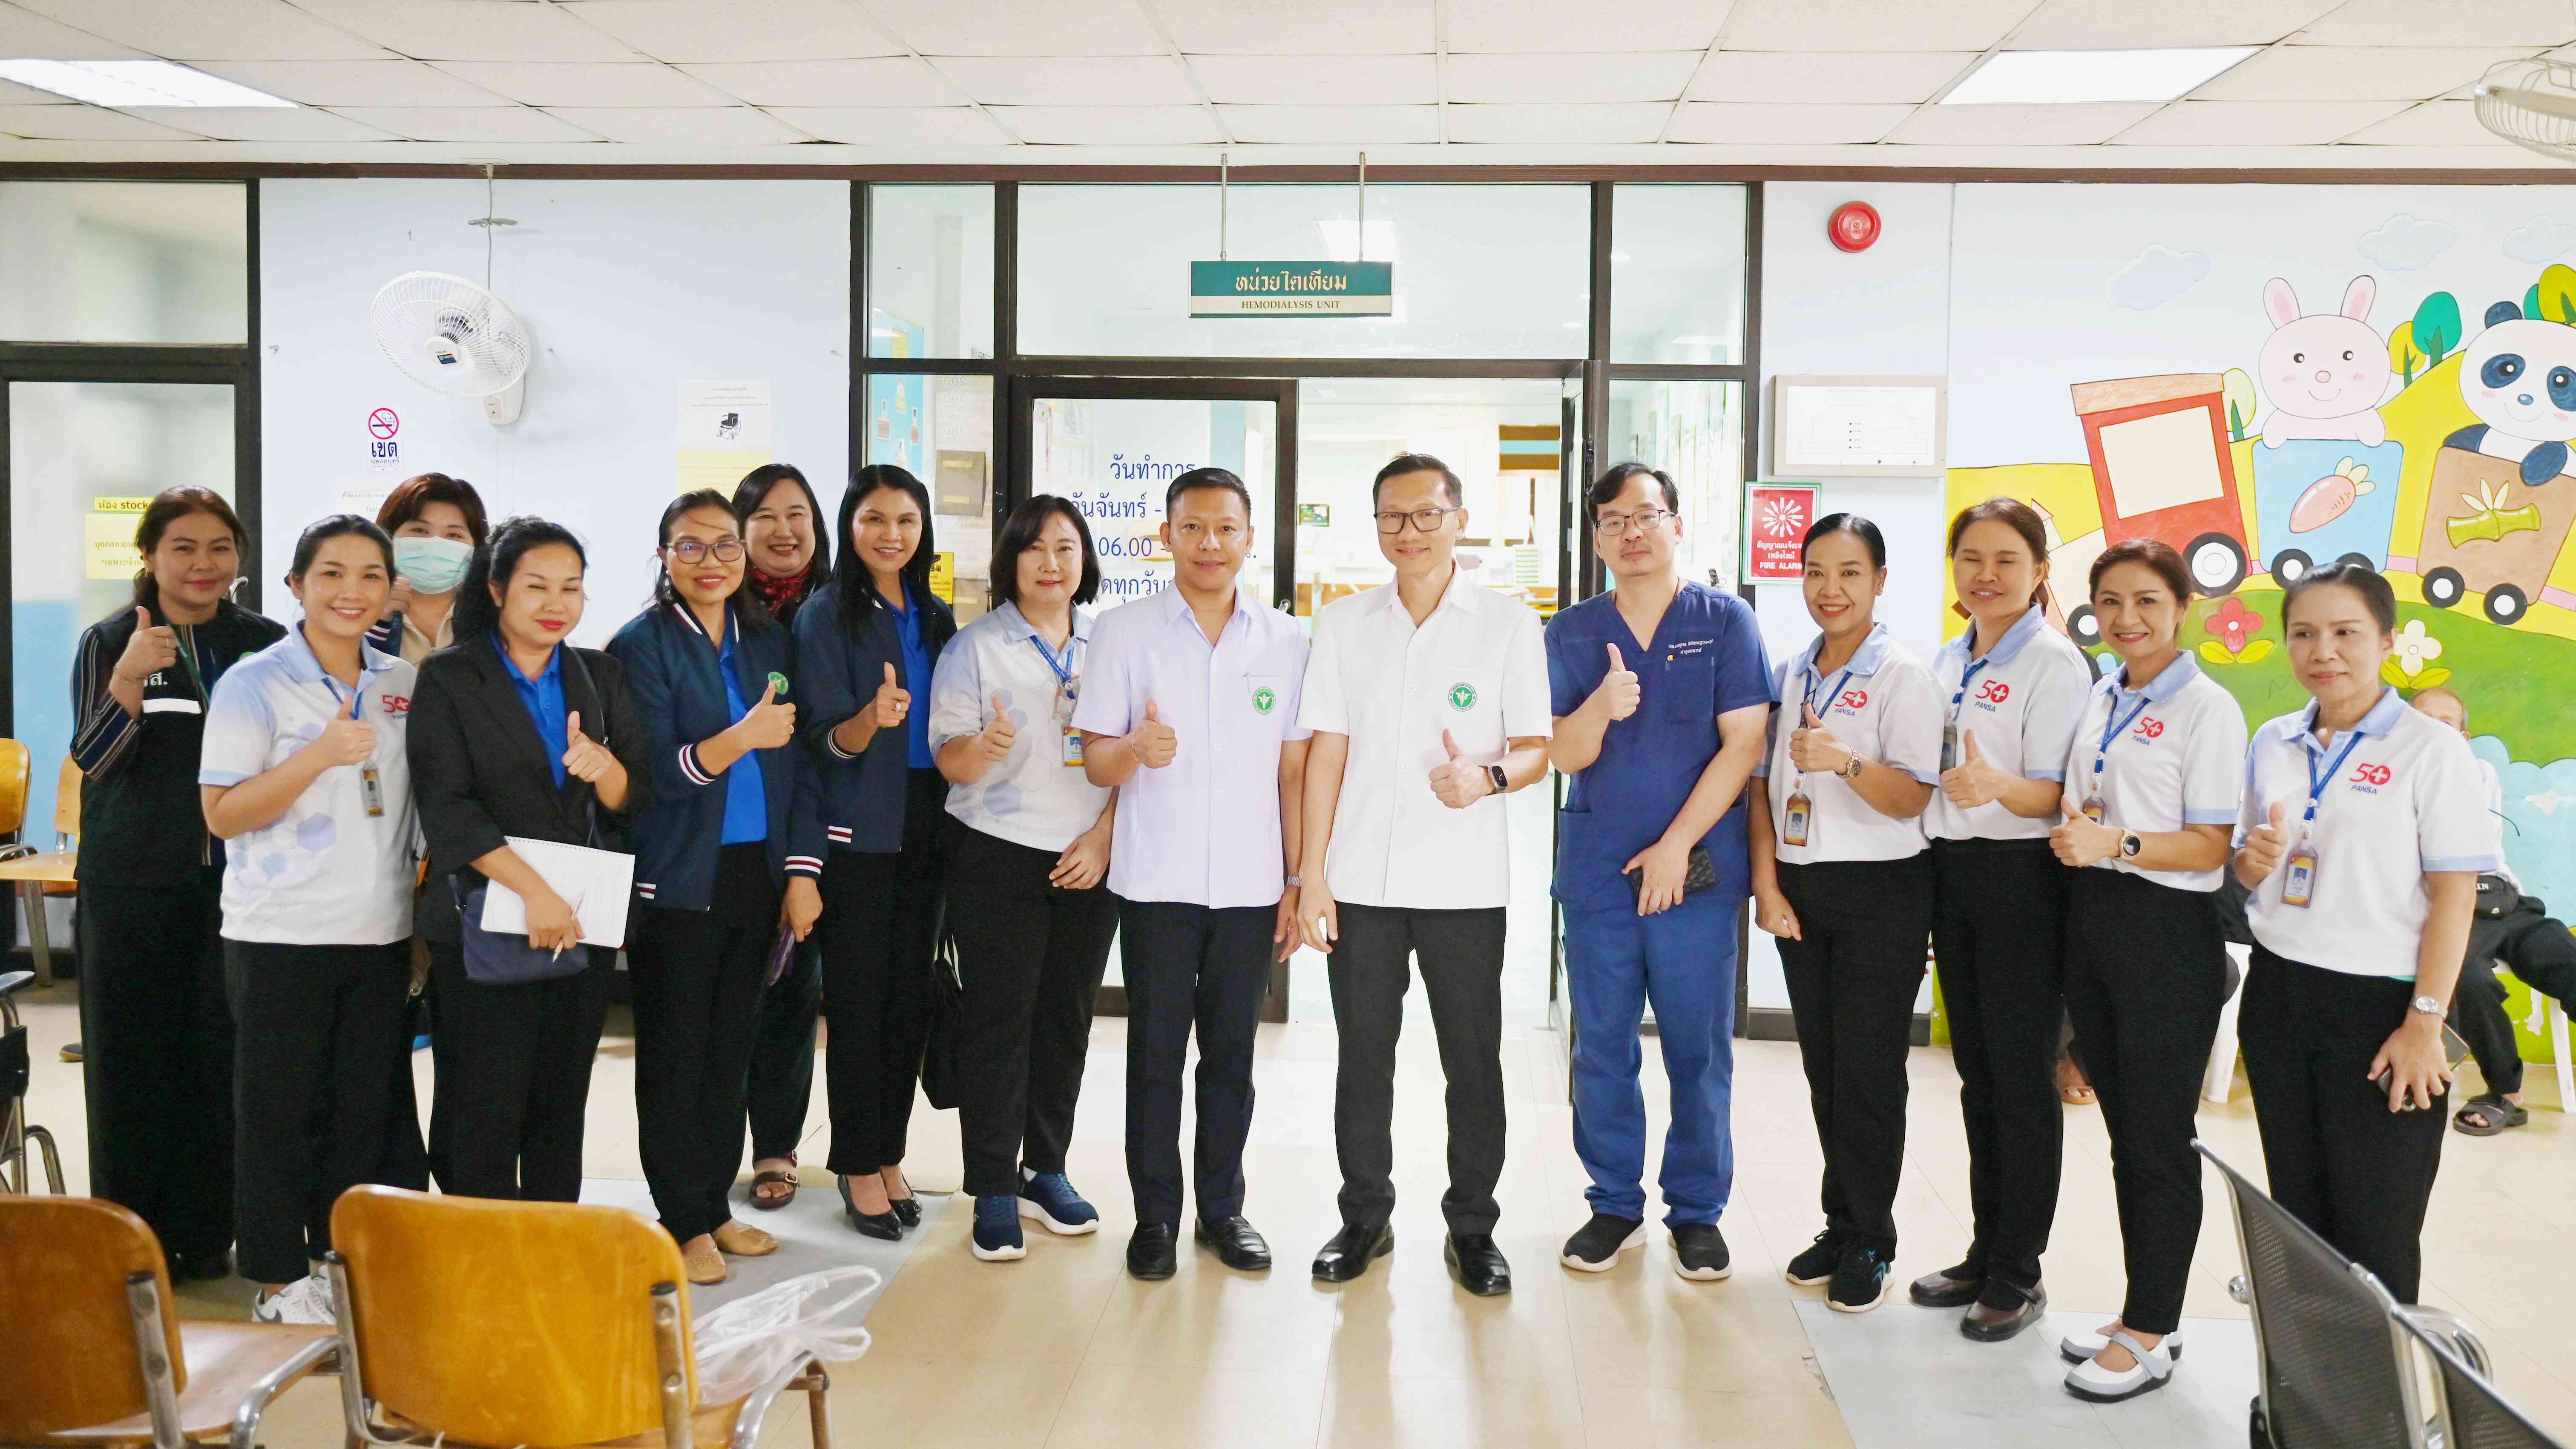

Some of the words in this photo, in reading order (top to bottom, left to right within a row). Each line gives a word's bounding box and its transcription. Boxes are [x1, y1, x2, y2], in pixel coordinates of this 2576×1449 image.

[1235, 267, 1346, 291] หน่วยไตเทียม
[1242, 301, 1313, 309] HEMODIALYSIS
[1317, 301, 1340, 309] UNIT
[372, 442, 397, 457] เขต
[98, 499, 117, 509] ห้อง
[121, 500, 149, 509] stock
[1099, 537, 1152, 556] 06.00
[1768, 550, 1795, 559] เพลิงไหม้
[1974, 701, 1995, 712] PANSA
[1834, 708, 1855, 716] PANSA
[2131, 735, 2150, 746] PANSA
[2351, 785, 2377, 794] PANSA
